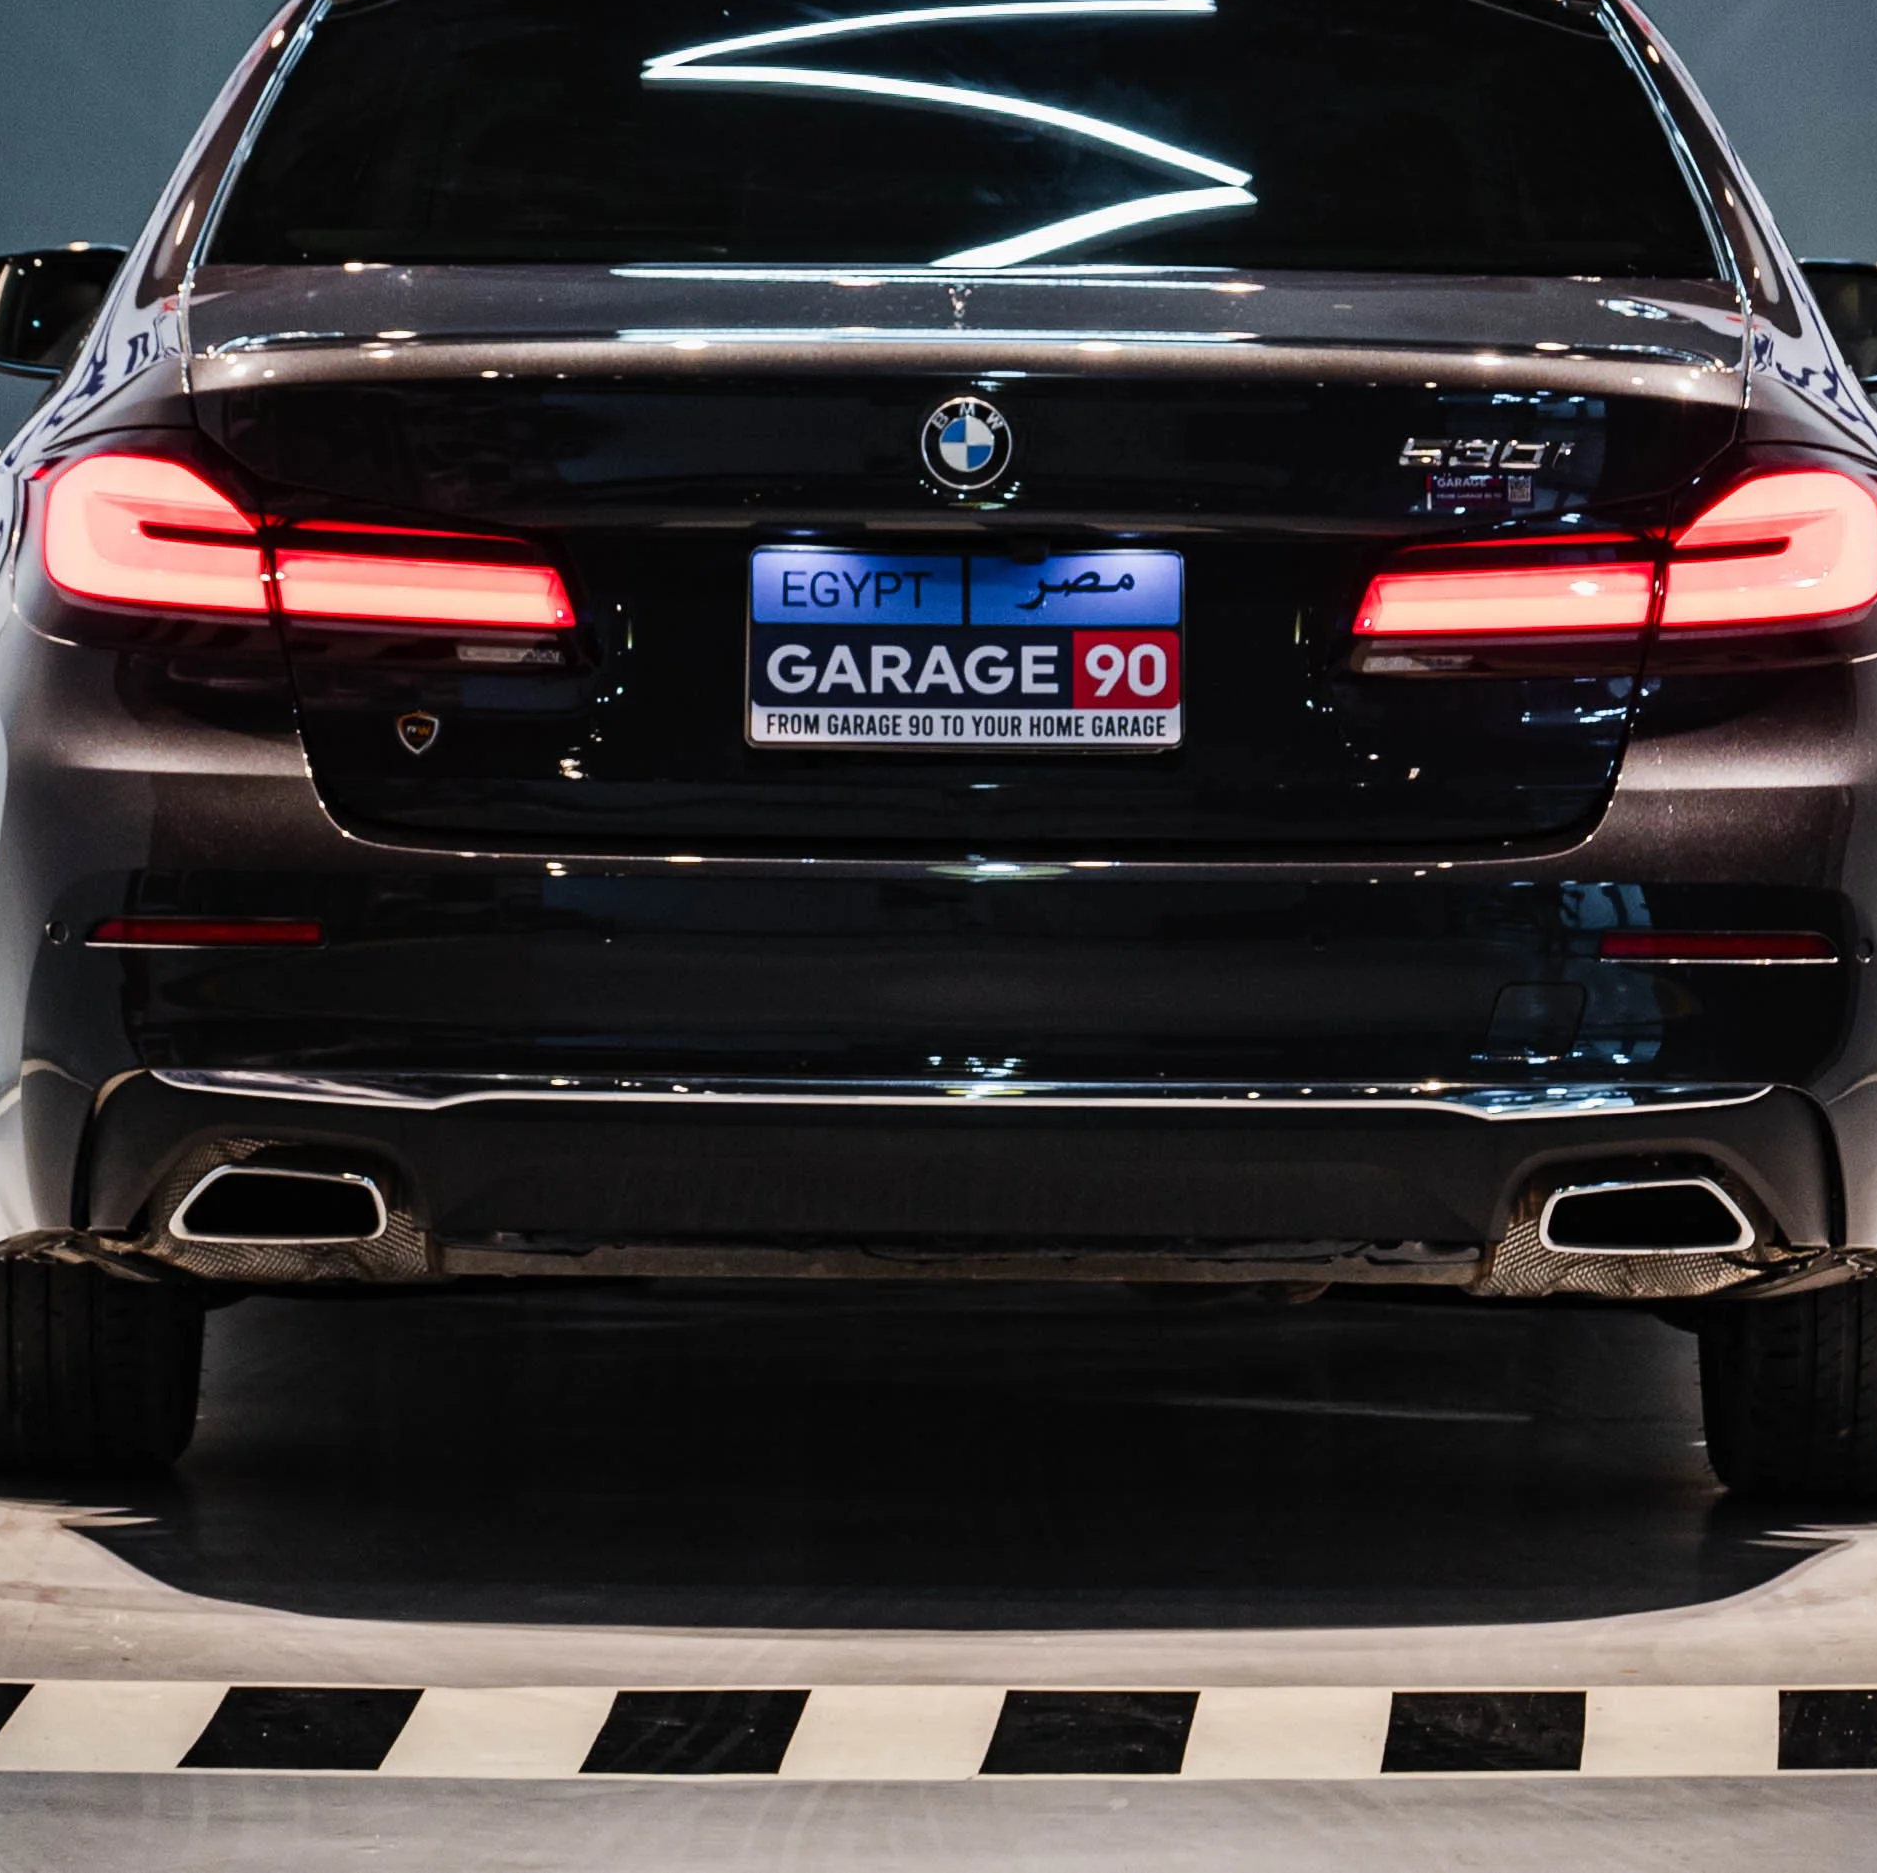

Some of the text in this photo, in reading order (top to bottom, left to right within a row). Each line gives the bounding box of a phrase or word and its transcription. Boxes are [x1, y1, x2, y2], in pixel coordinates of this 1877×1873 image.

[931, 403, 1005, 430] BMW
[782, 570, 933, 608] EGYPT
[1015, 571, 1135, 610] مصر
[767, 644, 1166, 696] GARAGE 90
[767, 713, 1167, 737] FROM GARAGE 90 TO YOUR HOME GARAGE
